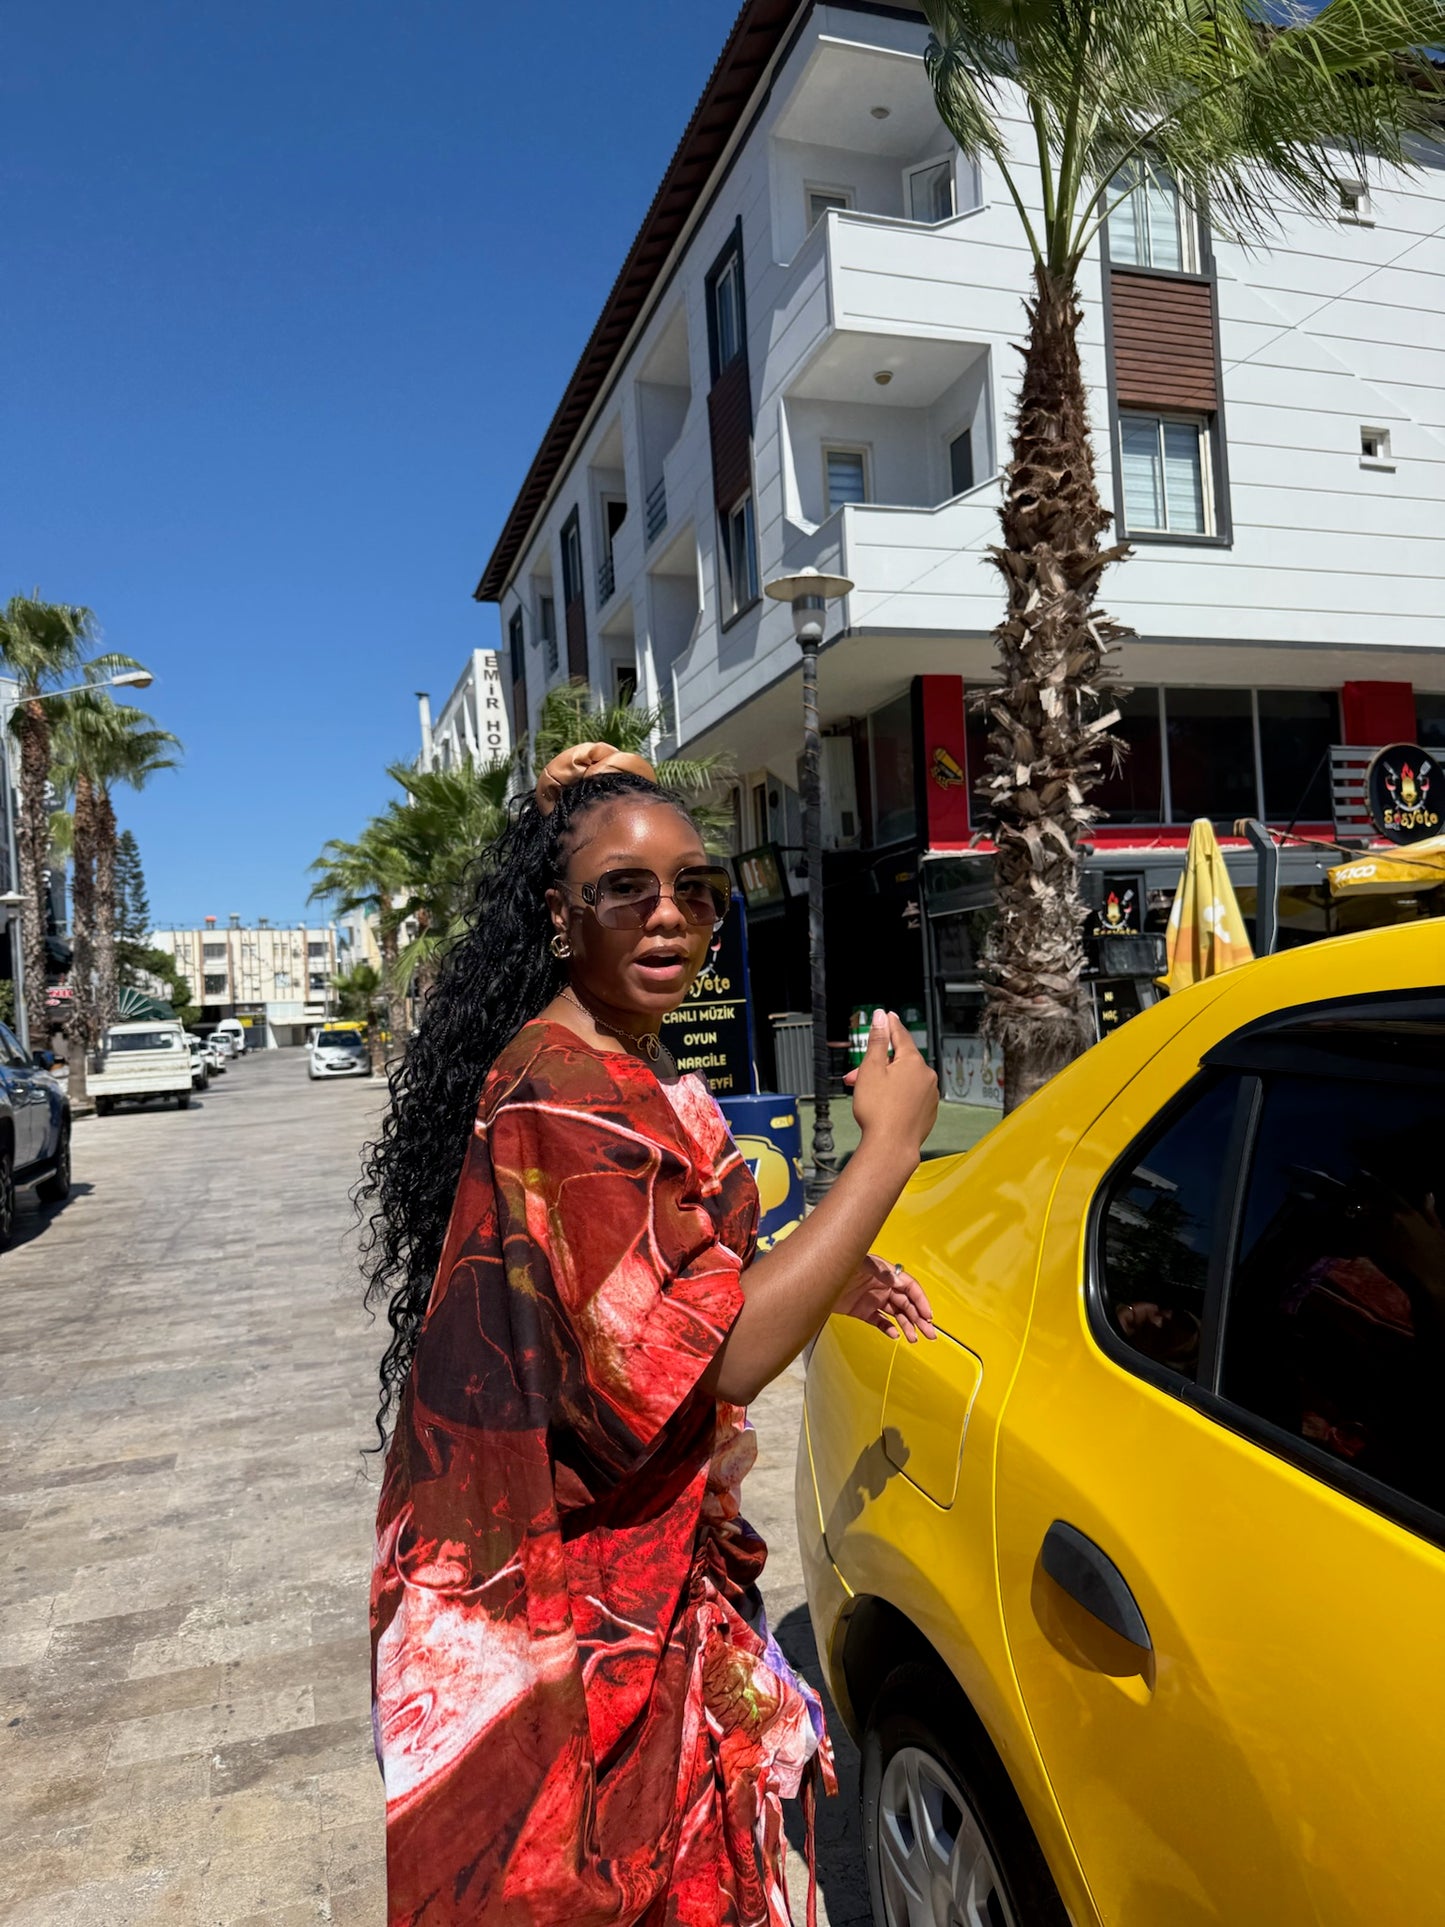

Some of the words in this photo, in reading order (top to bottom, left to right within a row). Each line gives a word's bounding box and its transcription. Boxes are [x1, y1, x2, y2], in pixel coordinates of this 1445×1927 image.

[487, 720, 501, 769] HOT
[662, 1010, 697, 1024] CANLI
[700, 1005, 735, 1021] MÜZİK
[683, 1032, 717, 1046] OYUN
[677, 1053, 727, 1070] NARGİLE
[707, 1074, 733, 1090] EYFİ
